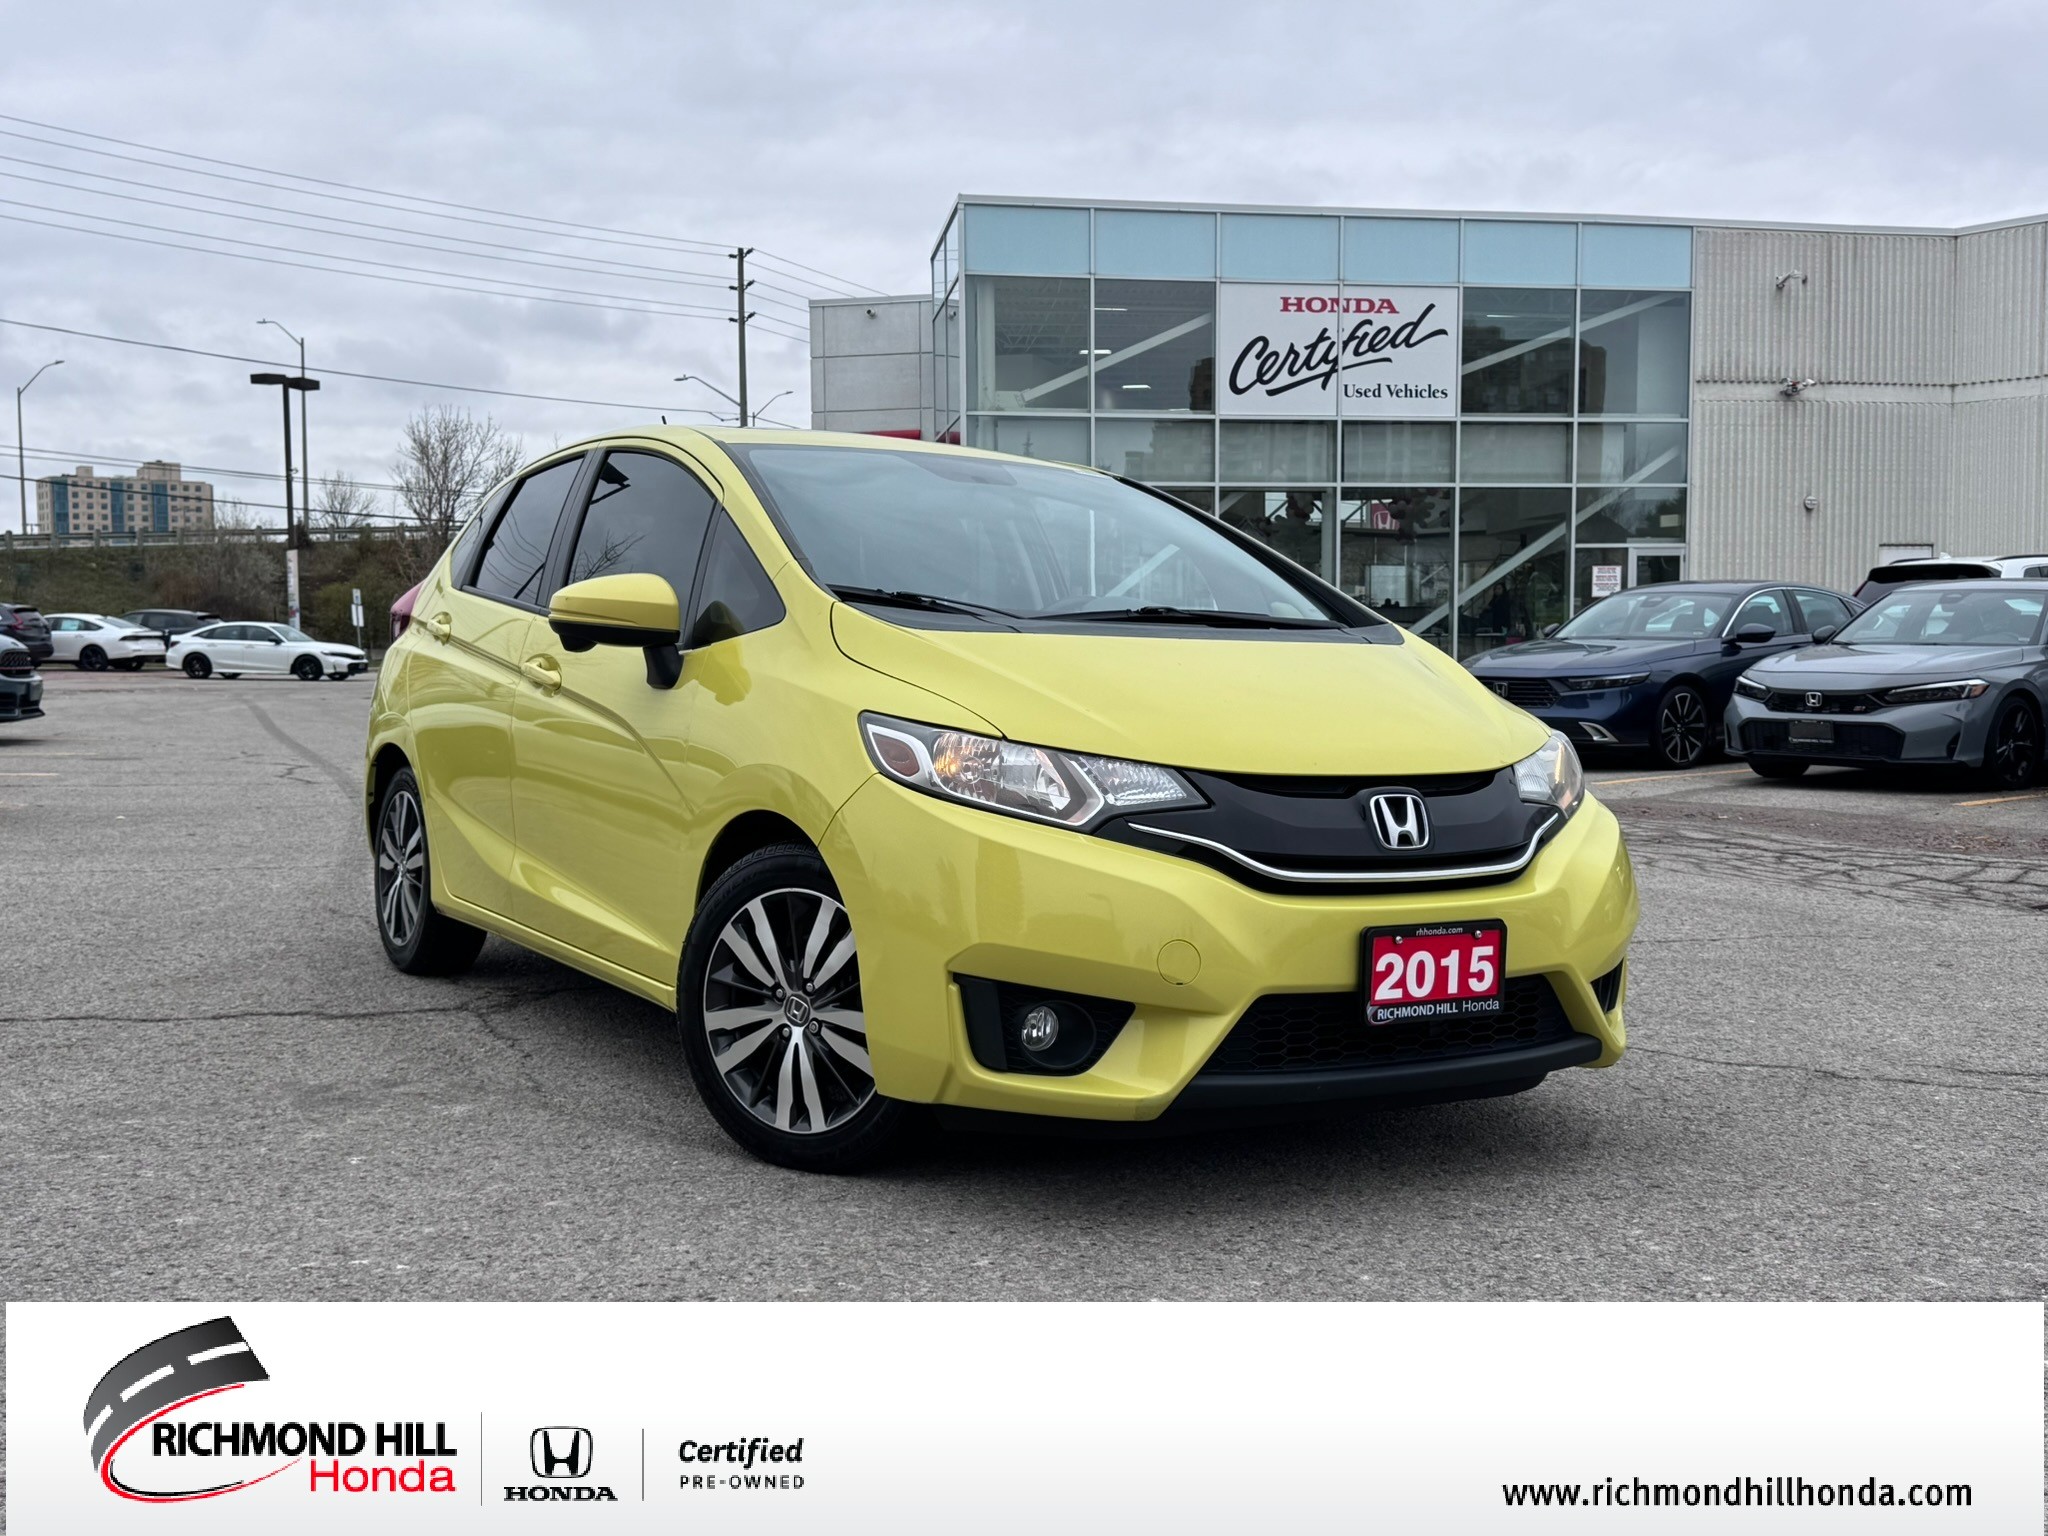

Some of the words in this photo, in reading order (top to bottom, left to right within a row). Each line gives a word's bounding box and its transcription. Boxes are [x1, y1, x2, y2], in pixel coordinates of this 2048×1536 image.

[1280, 297, 1399, 314] HONDA
[1229, 303, 1448, 397] Certified
[1343, 383, 1381, 398] Used
[1386, 383, 1448, 399] Vehicles
[1415, 926, 1463, 936] rhhonda.com
[1374, 945, 1494, 1000] 2015
[1377, 1004, 1435, 1021] RICHMOND
[1436, 1002, 1458, 1014] HILL
[1462, 998, 1500, 1012] Honda
